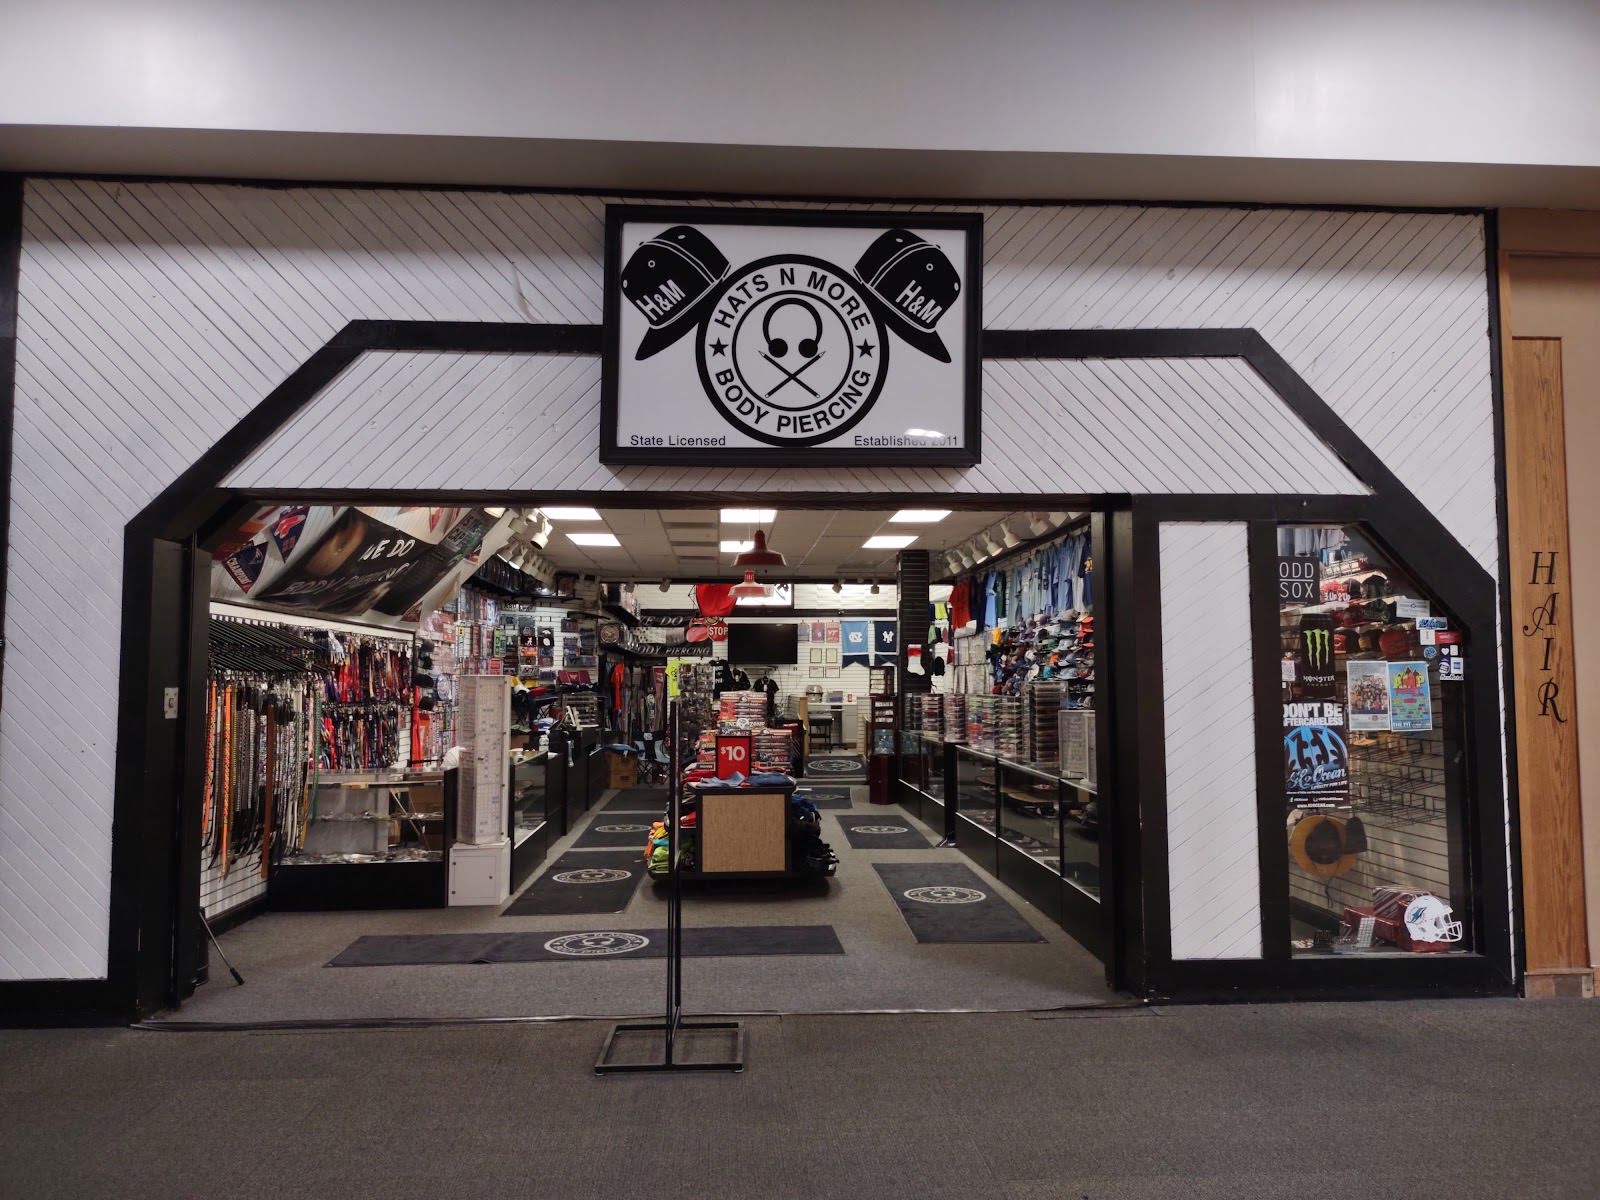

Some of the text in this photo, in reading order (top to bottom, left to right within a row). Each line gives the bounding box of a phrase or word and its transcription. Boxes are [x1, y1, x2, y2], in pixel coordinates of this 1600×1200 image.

[635, 279, 686, 321] H&M
[714, 267, 871, 330] HATS N MORE
[895, 279, 943, 324] H&M
[715, 368, 871, 434] BODY PIERCING
[630, 434, 726, 446] State Licensed
[854, 435, 926, 446] Established
[386, 539, 416, 558] DO
[1279, 562, 1314, 579] ODD
[1280, 581, 1314, 599] SOX
[708, 626, 729, 636] STOP
[1523, 552, 1567, 723] HAIR
[665, 647, 710, 655] PIERCING
[1323, 702, 1343, 718] BE
[720, 745, 746, 761] $10
